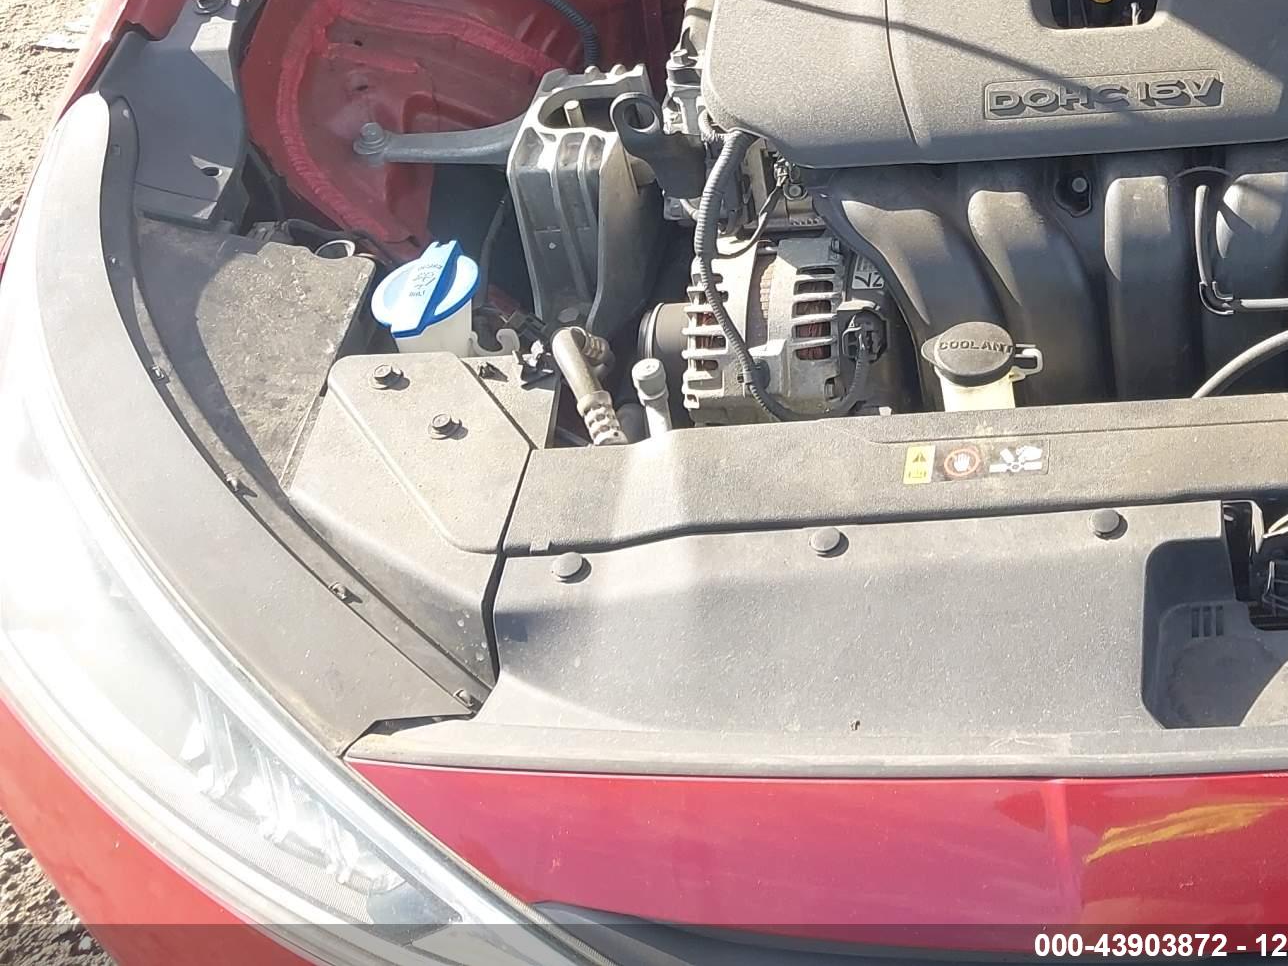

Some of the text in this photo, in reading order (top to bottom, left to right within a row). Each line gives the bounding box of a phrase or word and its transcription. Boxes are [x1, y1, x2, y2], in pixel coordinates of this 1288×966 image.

[989, 78, 1222, 112] DOHC 16V
[939, 339, 1011, 355] COOLANT
